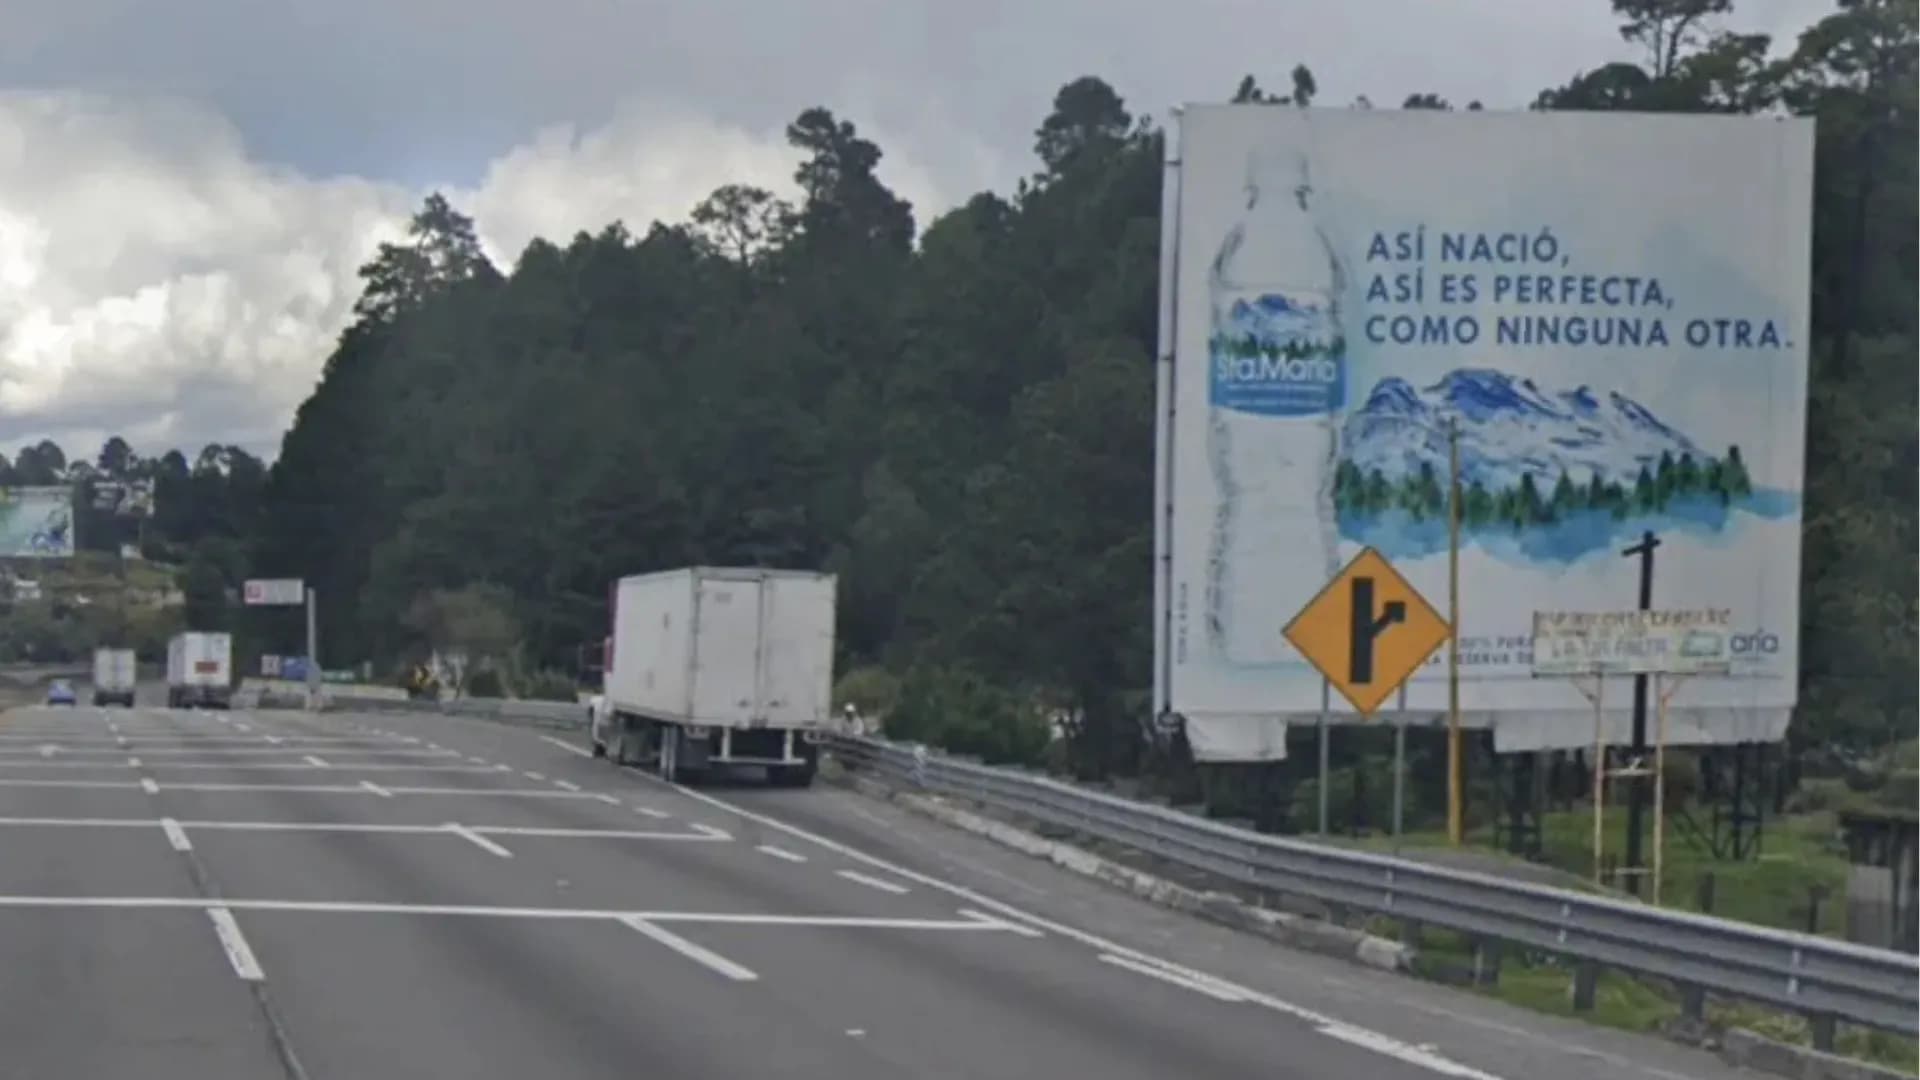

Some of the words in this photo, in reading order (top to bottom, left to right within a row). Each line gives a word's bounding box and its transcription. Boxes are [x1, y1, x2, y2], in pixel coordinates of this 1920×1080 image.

[1365, 225, 1425, 263] ASÍ
[1440, 226, 1570, 269] NACIÓ,
[1365, 267, 1424, 304] ASÍ
[1439, 273, 1479, 305] ES
[1493, 274, 1674, 311] PERFECTA,
[1363, 313, 1481, 346] COMO
[1495, 314, 1670, 347] NINGUNA
[1684, 318, 1794, 350] OTRA.
